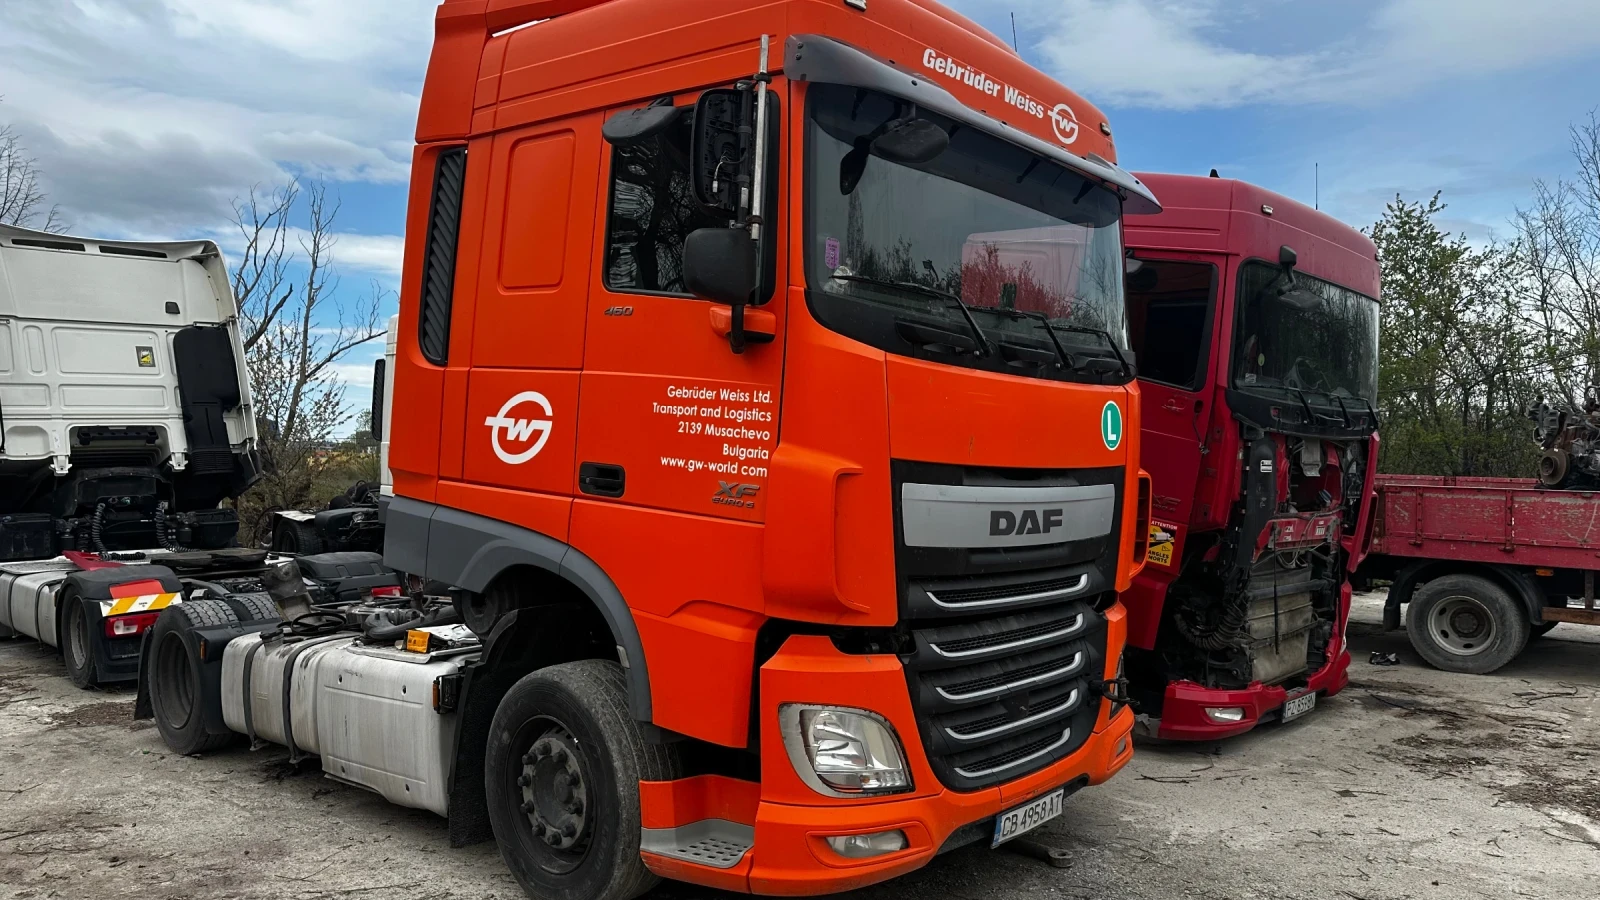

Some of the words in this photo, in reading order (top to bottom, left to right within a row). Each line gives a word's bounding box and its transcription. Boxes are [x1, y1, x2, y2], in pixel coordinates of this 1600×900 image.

[922, 48, 1001, 97] Gebrüder
[1004, 84, 1044, 119] Weiss
[604, 306, 634, 316] 460
[667, 385, 717, 400] Gebrüder
[720, 388, 750, 402] Weiss
[753, 390, 773, 403] Ltd.
[652, 402, 698, 417] Transport
[700, 406, 721, 418] and
[724, 406, 772, 422] Logistics
[678, 421, 702, 434] 2139
[704, 423, 770, 440] Musachevo
[723, 443, 769, 460] Bulgaria
[715, 480, 760, 498] XF
[711, 496, 744, 508] EURO
[989, 509, 1063, 536] DAF
[1151, 520, 1178, 531] ATTENTION
[1147, 554, 1168, 564] MORTS
[1148, 550, 1170, 560] ANGLES
[1020, 801, 1047, 829] 4958
